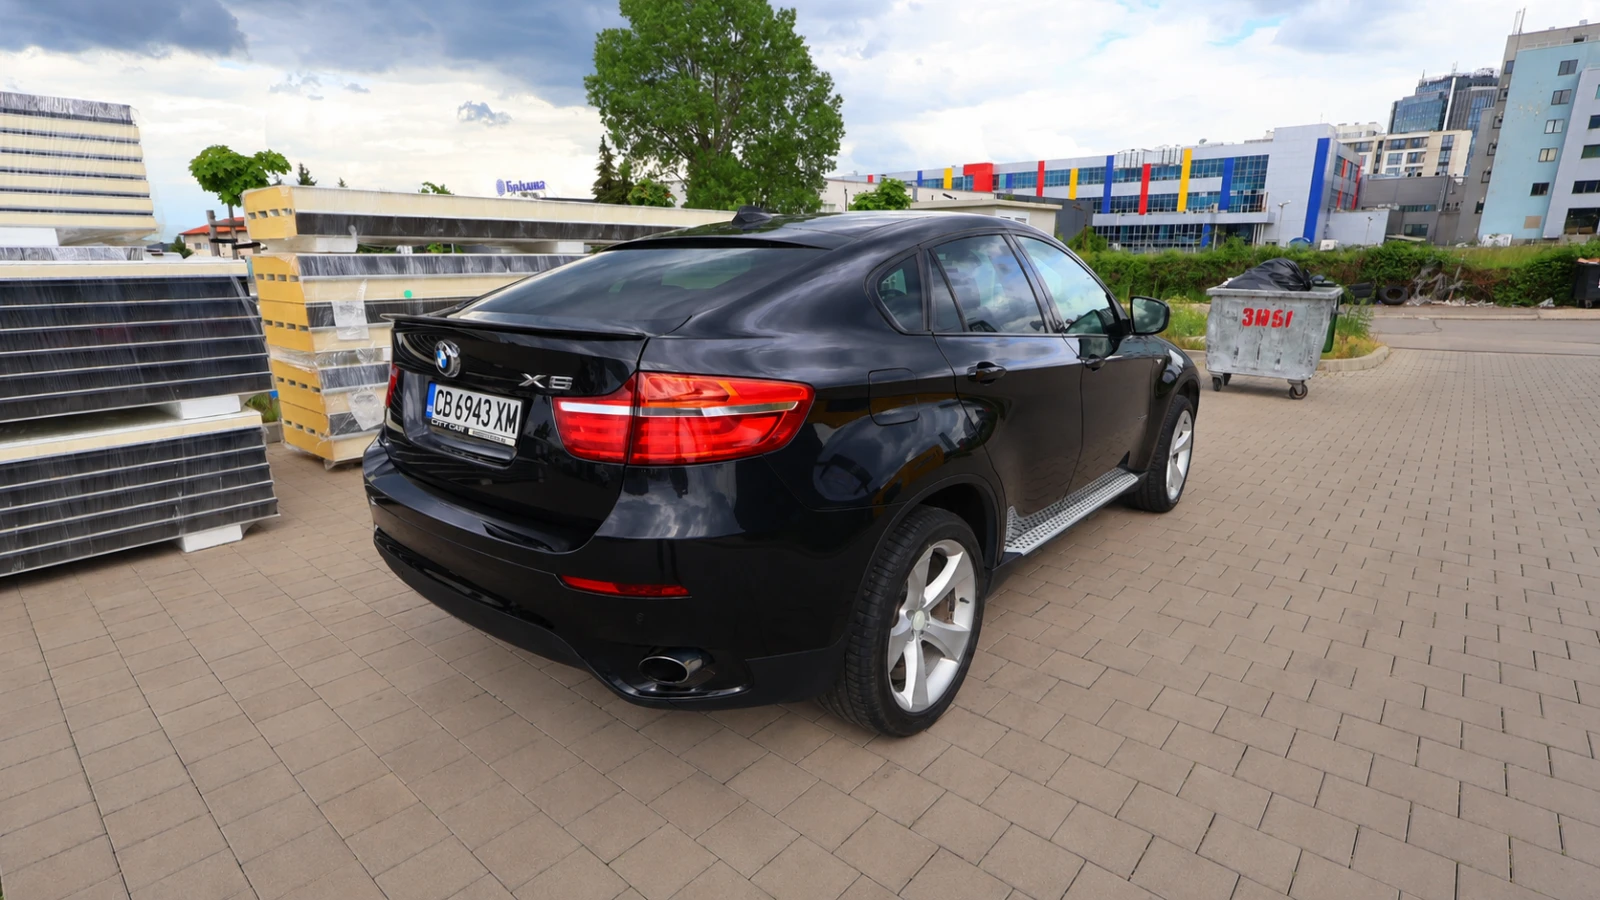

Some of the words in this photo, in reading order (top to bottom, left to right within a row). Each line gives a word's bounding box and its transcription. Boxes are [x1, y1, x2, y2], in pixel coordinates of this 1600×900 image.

[518, 373, 573, 390] X6
[434, 389, 453, 418] CB
[454, 394, 492, 428] 6943
[494, 401, 519, 434] XM
[430, 418, 448, 428] CITY
[448, 423, 465, 433] CAR
